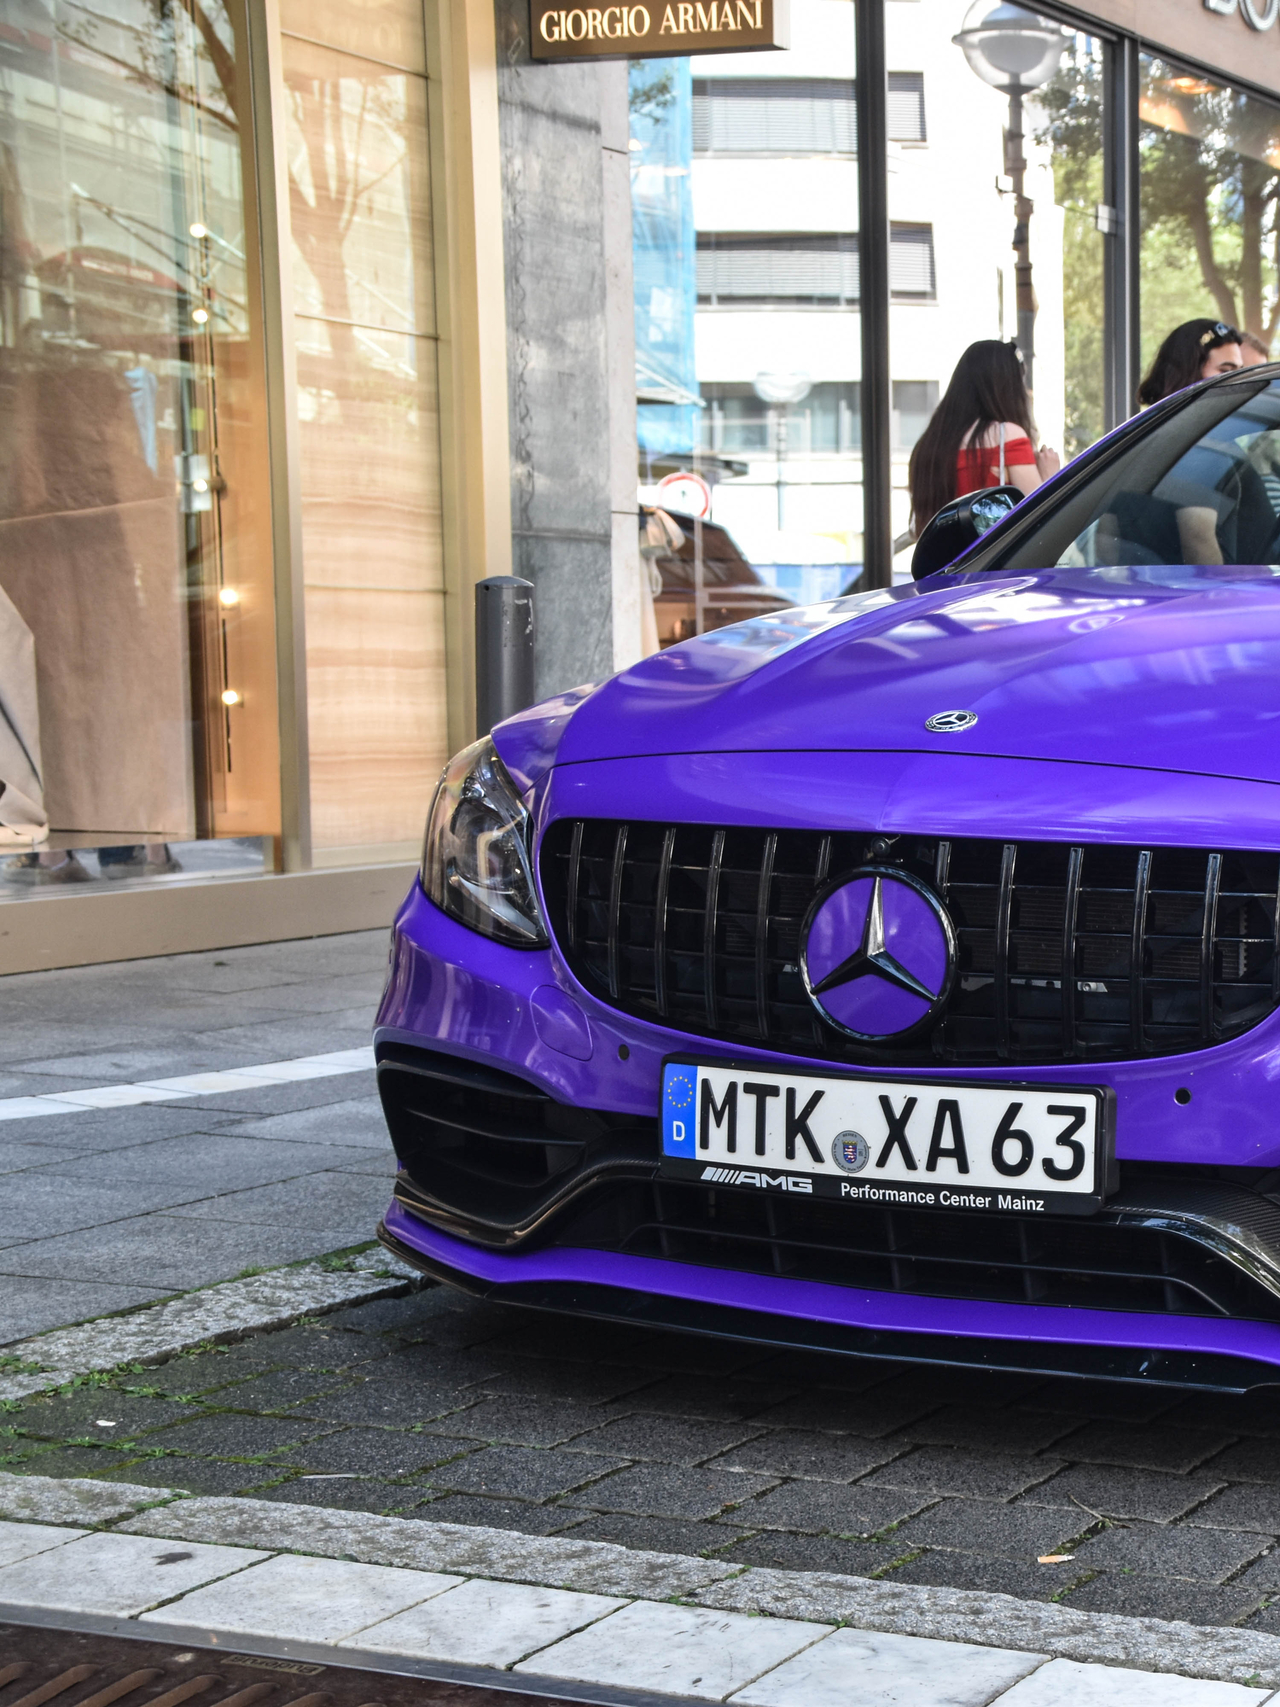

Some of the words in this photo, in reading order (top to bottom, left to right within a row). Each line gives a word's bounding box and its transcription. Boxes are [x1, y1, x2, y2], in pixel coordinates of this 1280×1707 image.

[539, 5, 650, 42] GIORGIO
[659, 0, 763, 35] ARMANI
[673, 1121, 686, 1141] D
[700, 1078, 826, 1163] MTK
[876, 1094, 970, 1174] XA
[991, 1102, 1088, 1181] 63
[738, 1172, 813, 1193] AMG
[841, 1182, 936, 1206] Performance
[940, 1189, 992, 1208] Center
[998, 1194, 1045, 1211] Mainz
